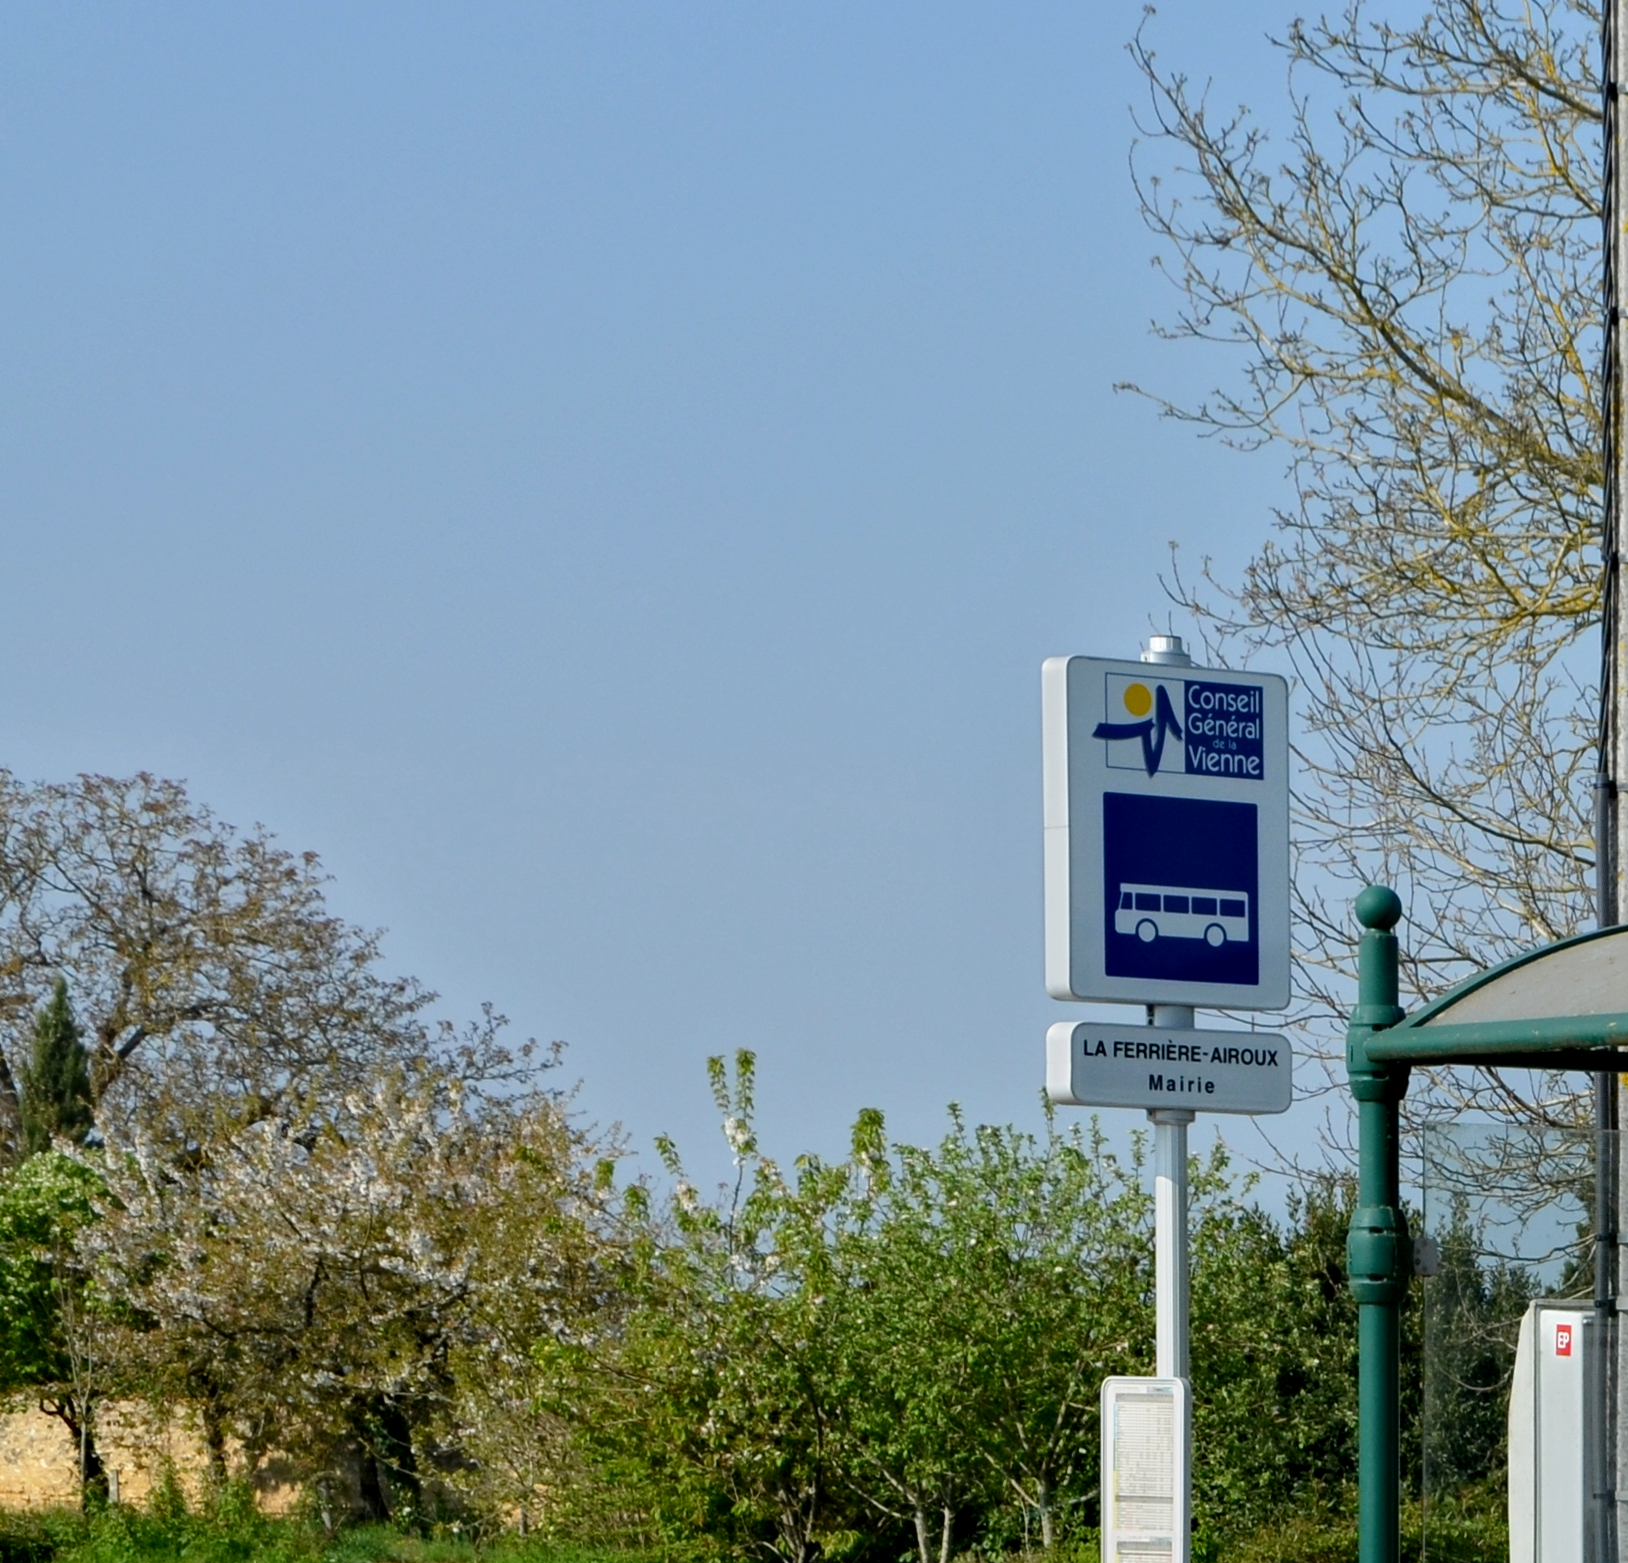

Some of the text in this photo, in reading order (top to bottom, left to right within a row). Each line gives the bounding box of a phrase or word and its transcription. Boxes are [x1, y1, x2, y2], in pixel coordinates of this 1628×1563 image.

[1188, 684, 1259, 713] Conseil
[1188, 712, 1259, 739] Général
[1212, 738, 1237, 750] de la
[1188, 744, 1260, 774] Vienne
[1083, 1039, 1279, 1067] LA FERRIÈRE-AIROUX
[1148, 1074, 1215, 1094] Mairie
